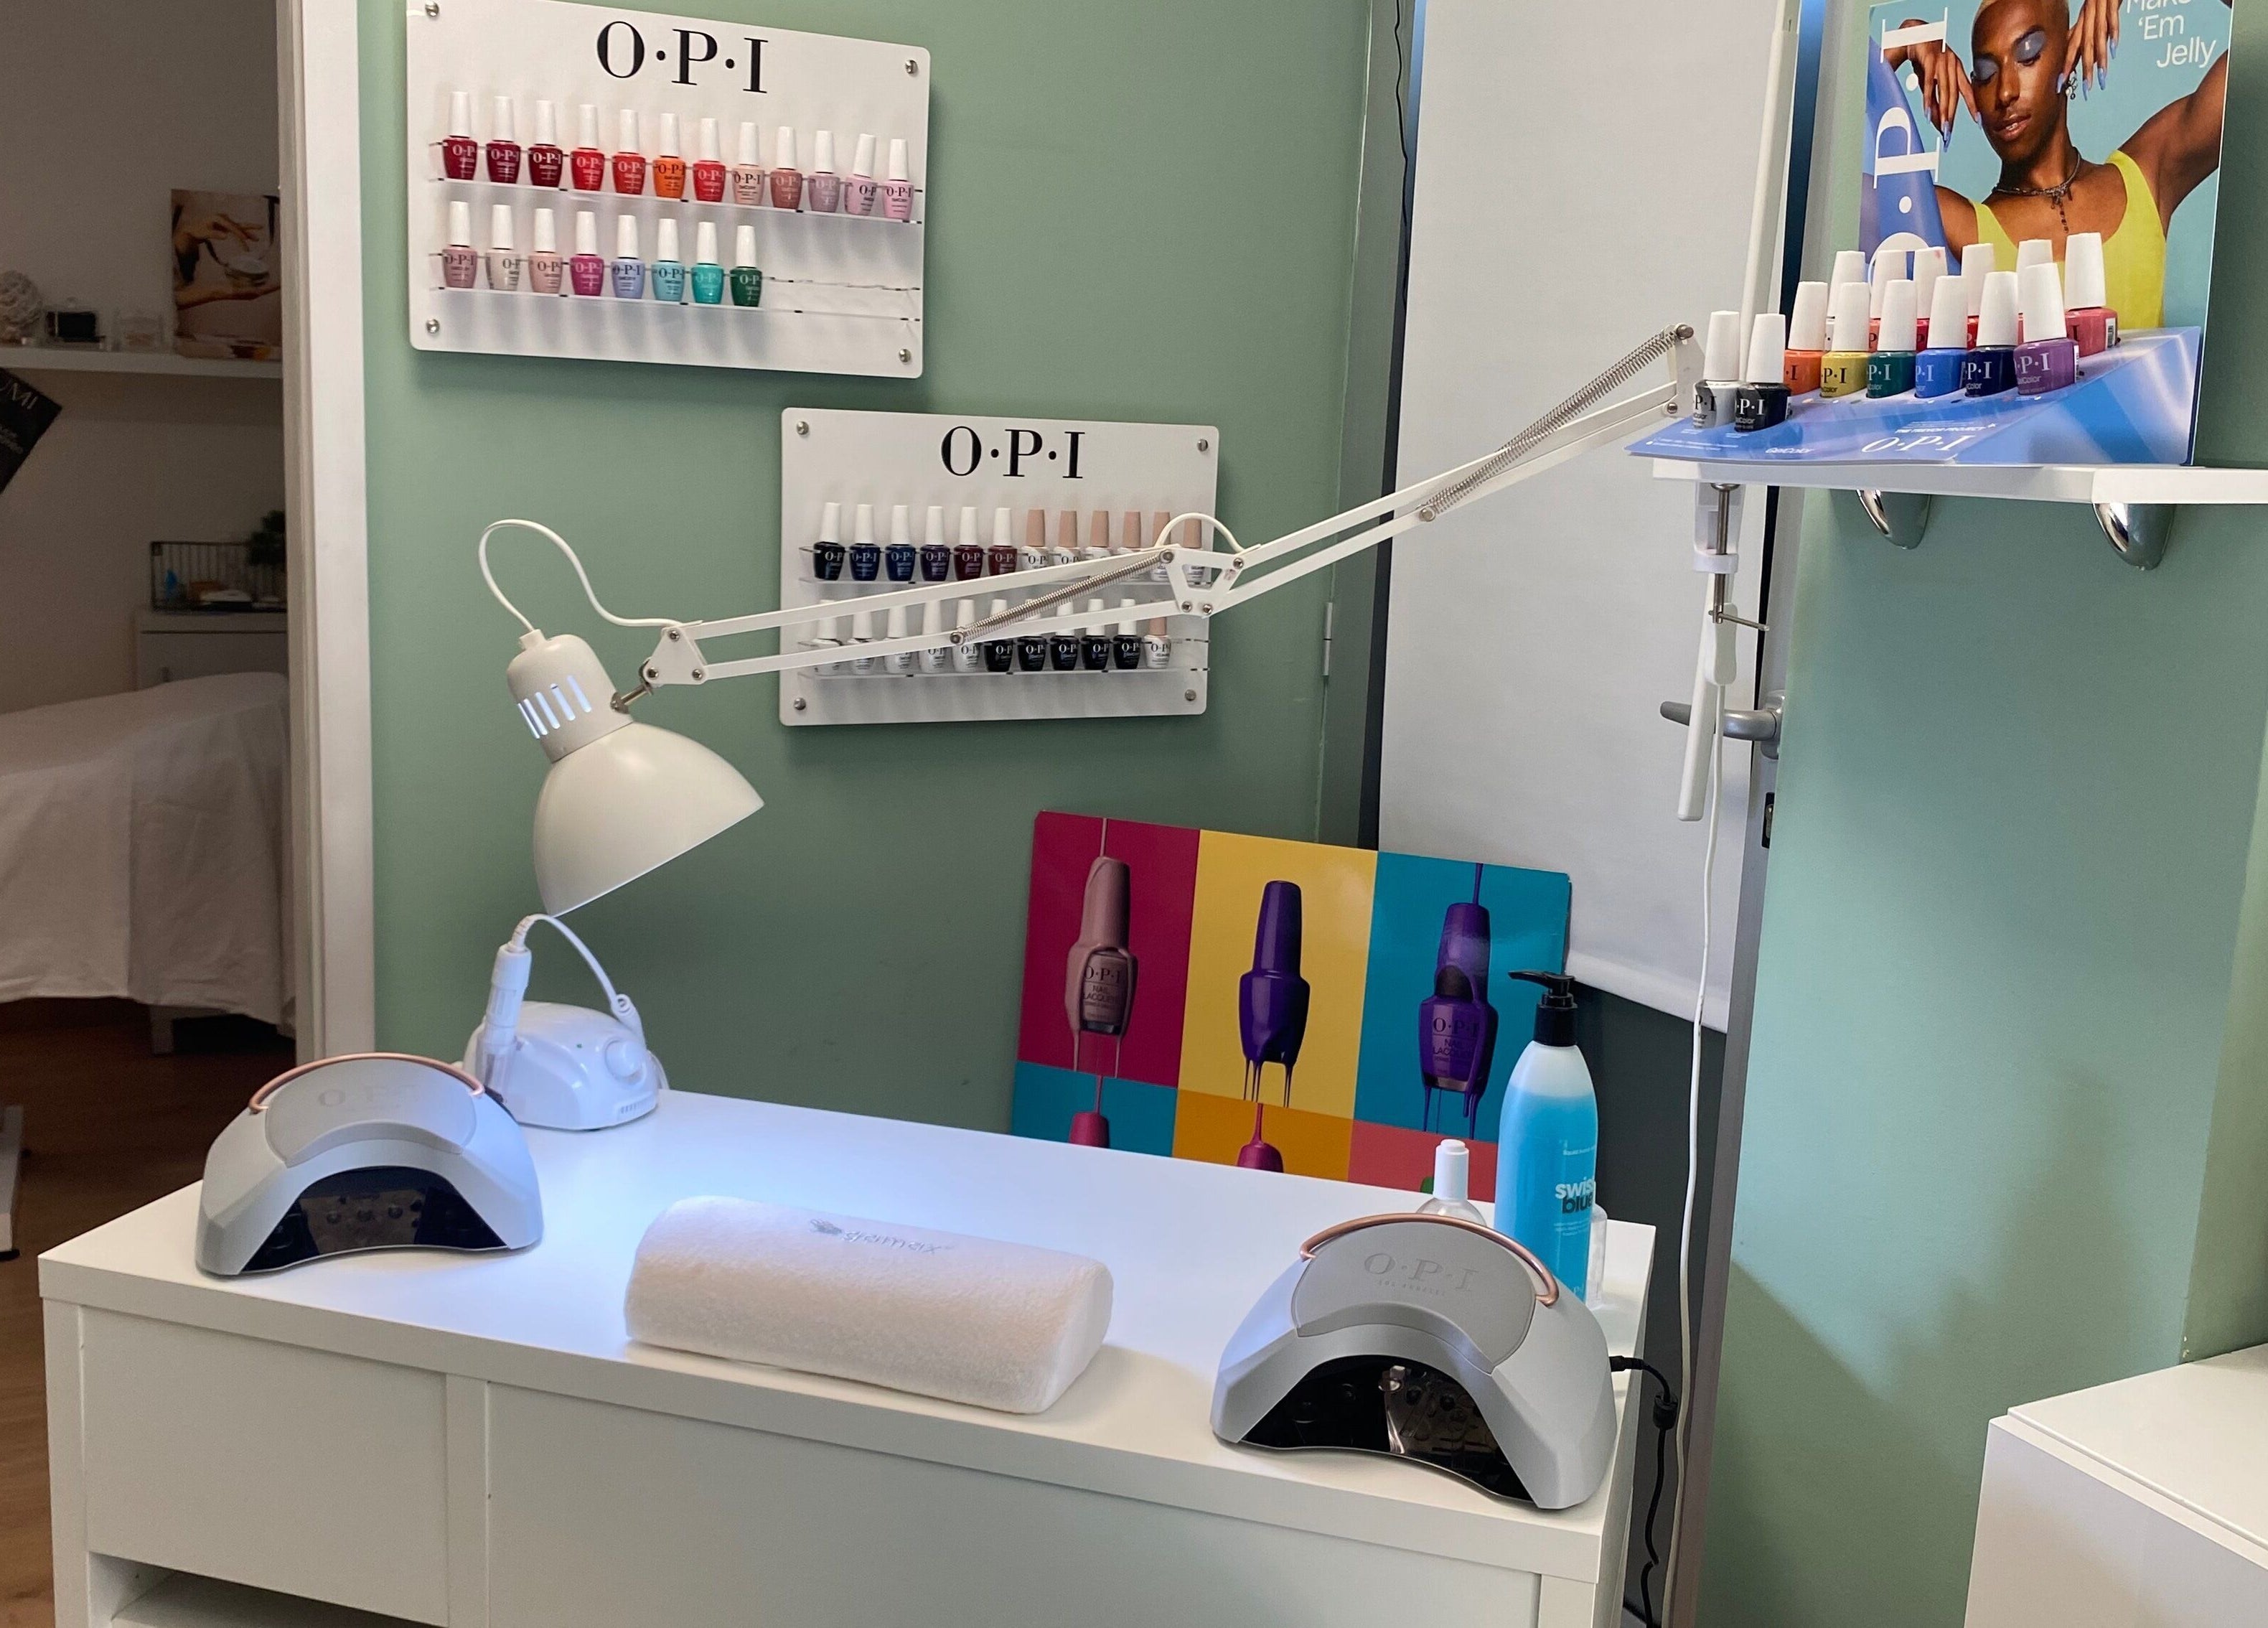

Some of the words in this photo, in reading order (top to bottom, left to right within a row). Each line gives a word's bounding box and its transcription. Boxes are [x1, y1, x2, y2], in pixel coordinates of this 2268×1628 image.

[2127, 0, 2190, 14] Ma
[2156, 37, 2216, 68] Jelly
[1555, 1176, 1595, 1199] swis
